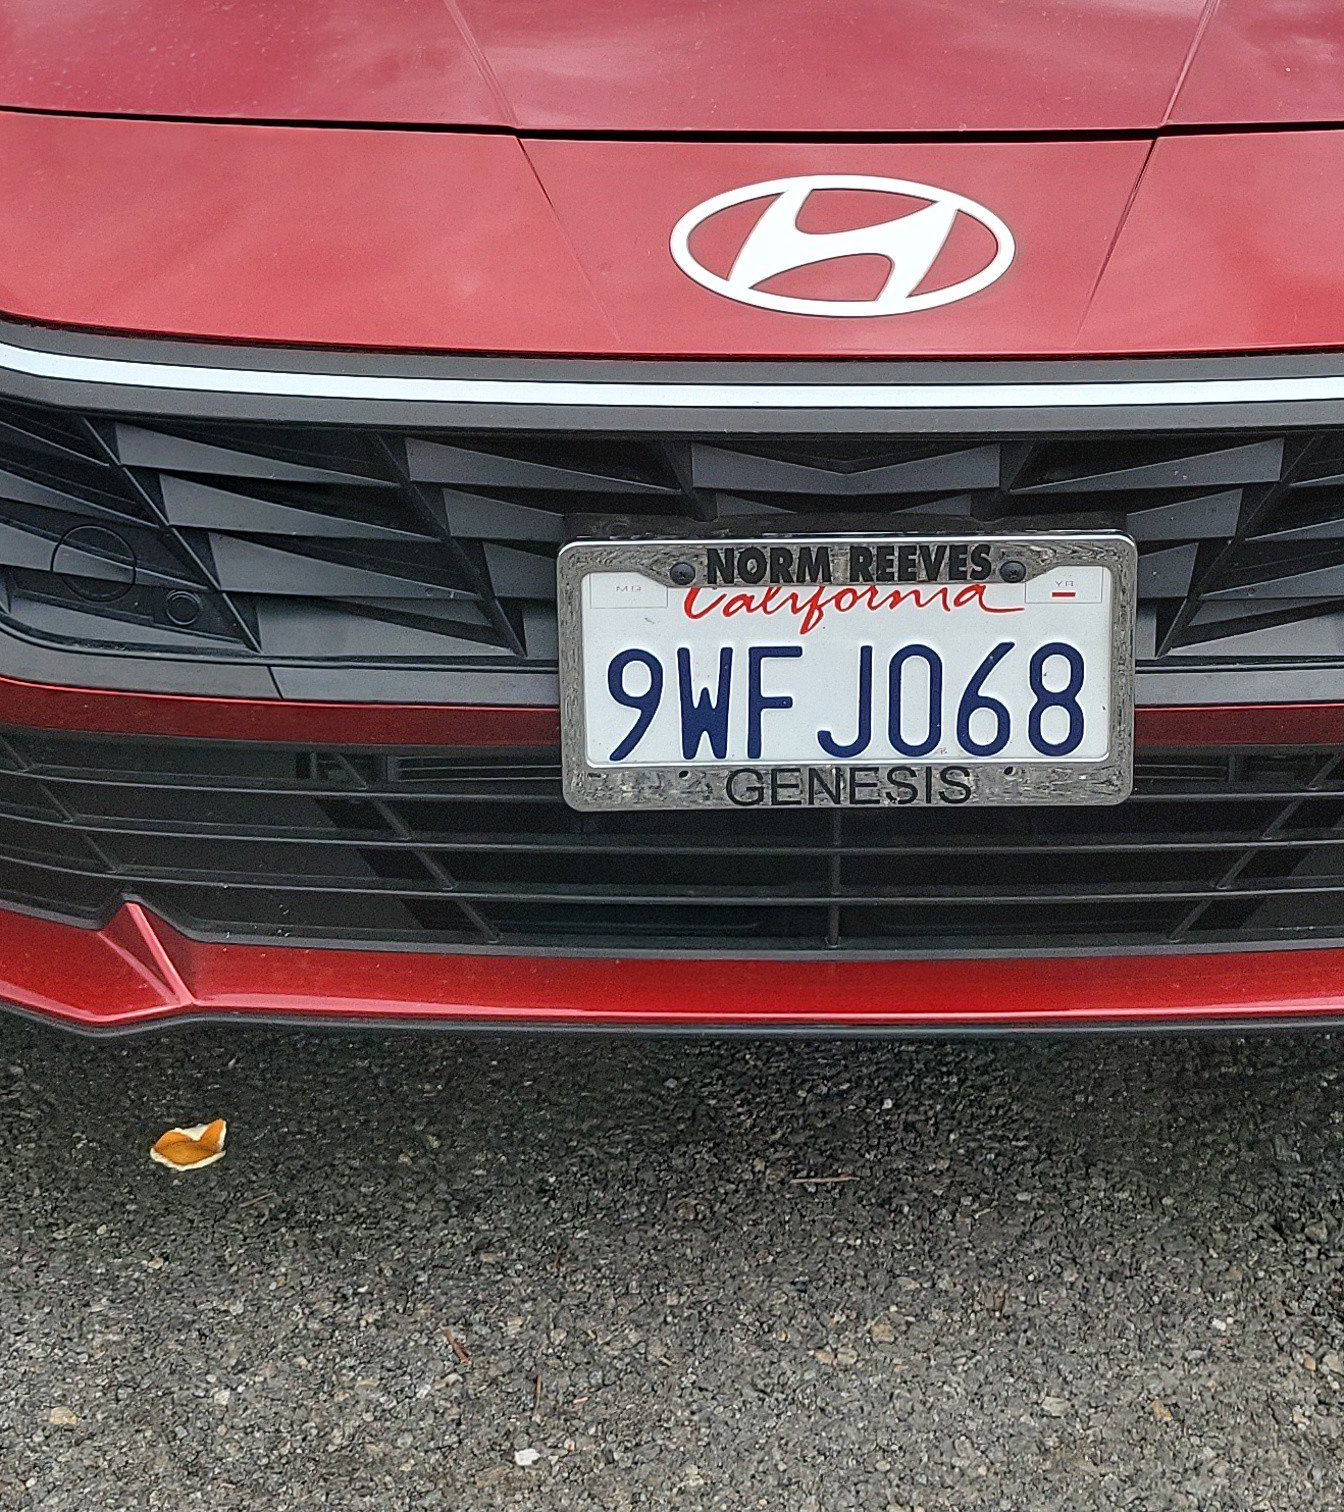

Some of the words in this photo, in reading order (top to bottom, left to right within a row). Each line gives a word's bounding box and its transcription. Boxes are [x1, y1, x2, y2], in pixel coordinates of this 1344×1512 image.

[707, 545, 830, 584] NORM
[850, 544, 992, 583] REEVES
[683, 584, 1025, 635] California
[607, 641, 1085, 761] 9WFJ068
[726, 765, 972, 806] GENESIS
